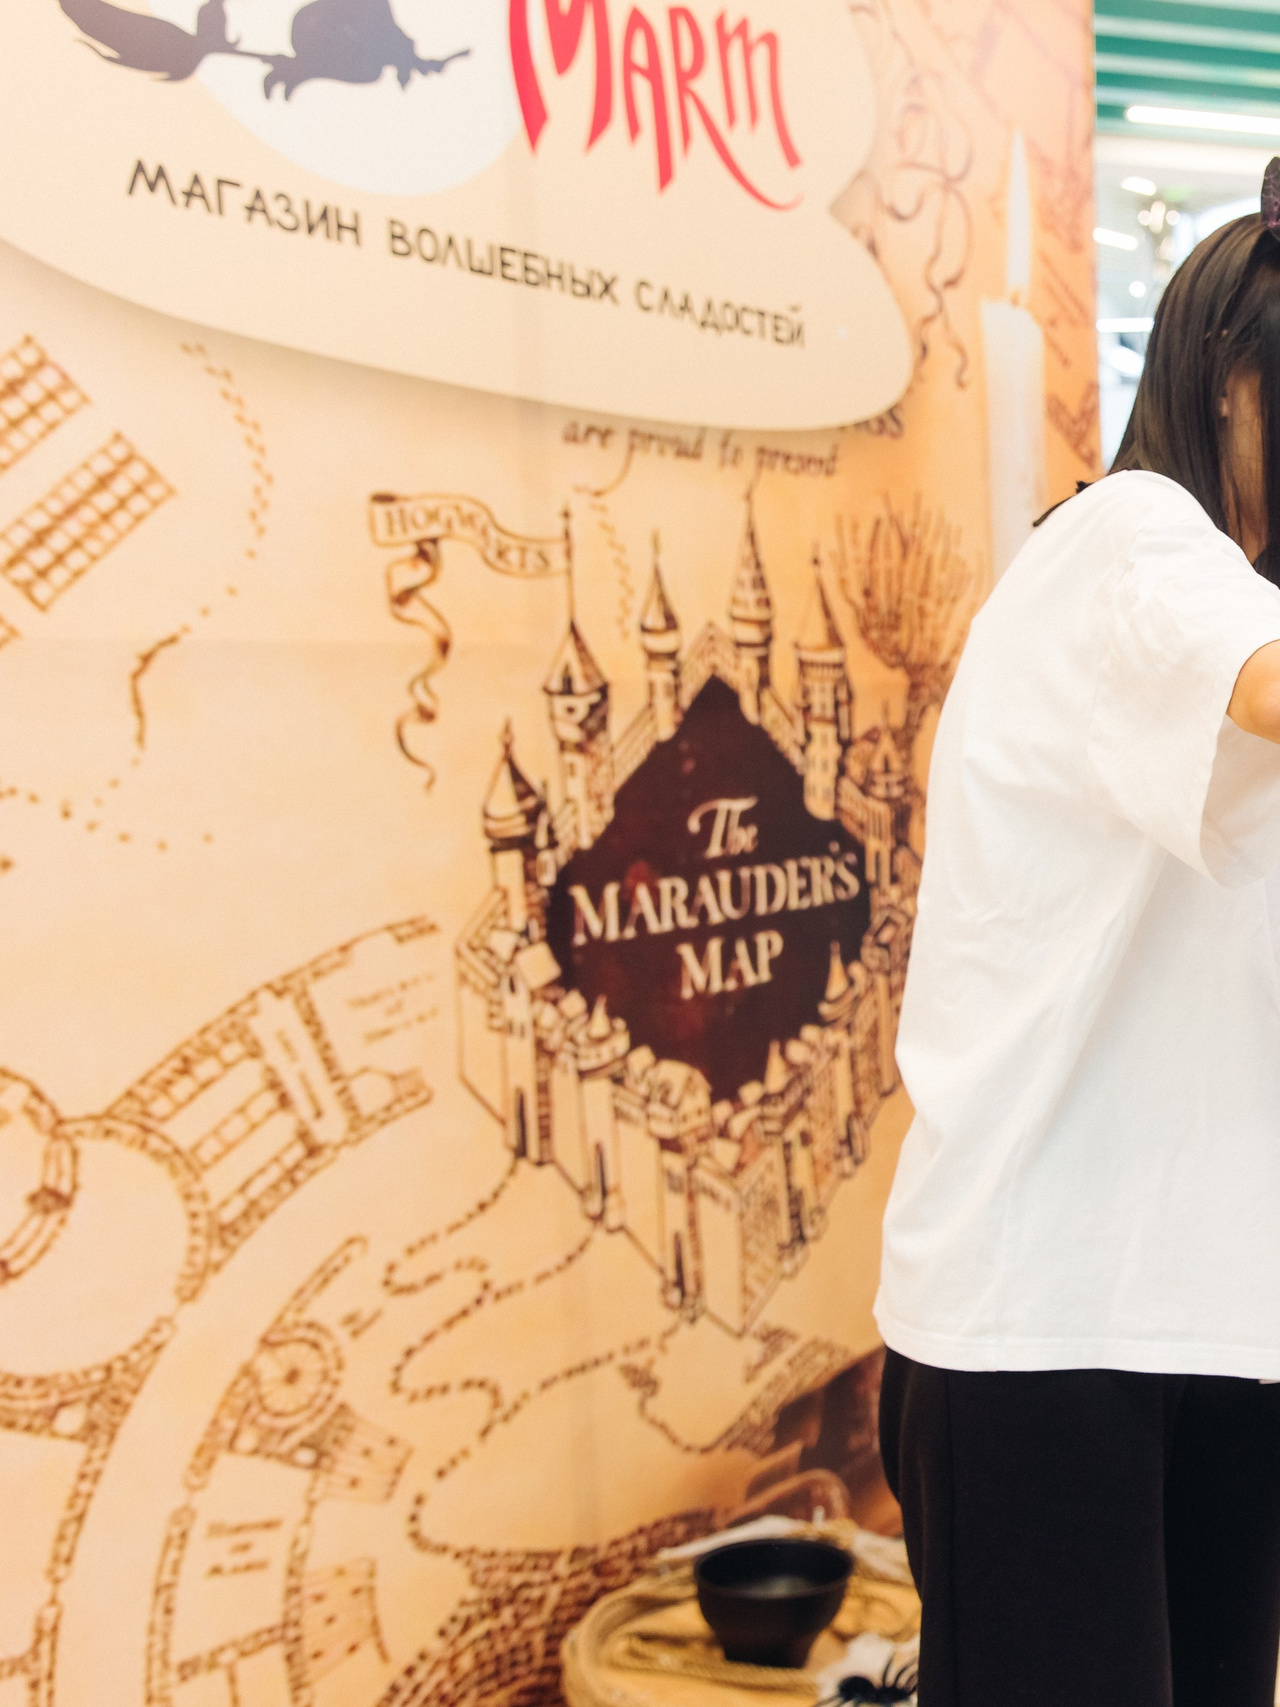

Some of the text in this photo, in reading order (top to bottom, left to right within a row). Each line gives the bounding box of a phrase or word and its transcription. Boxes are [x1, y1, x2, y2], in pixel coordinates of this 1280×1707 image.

[128, 159, 806, 349] МАГАЗИН ВОЛШЕБНЫХ СЛАДОСТЕЙ
[687, 795, 760, 859] The
[568, 840, 861, 948] MARAUDER'S
[676, 929, 785, 1000] MAP
